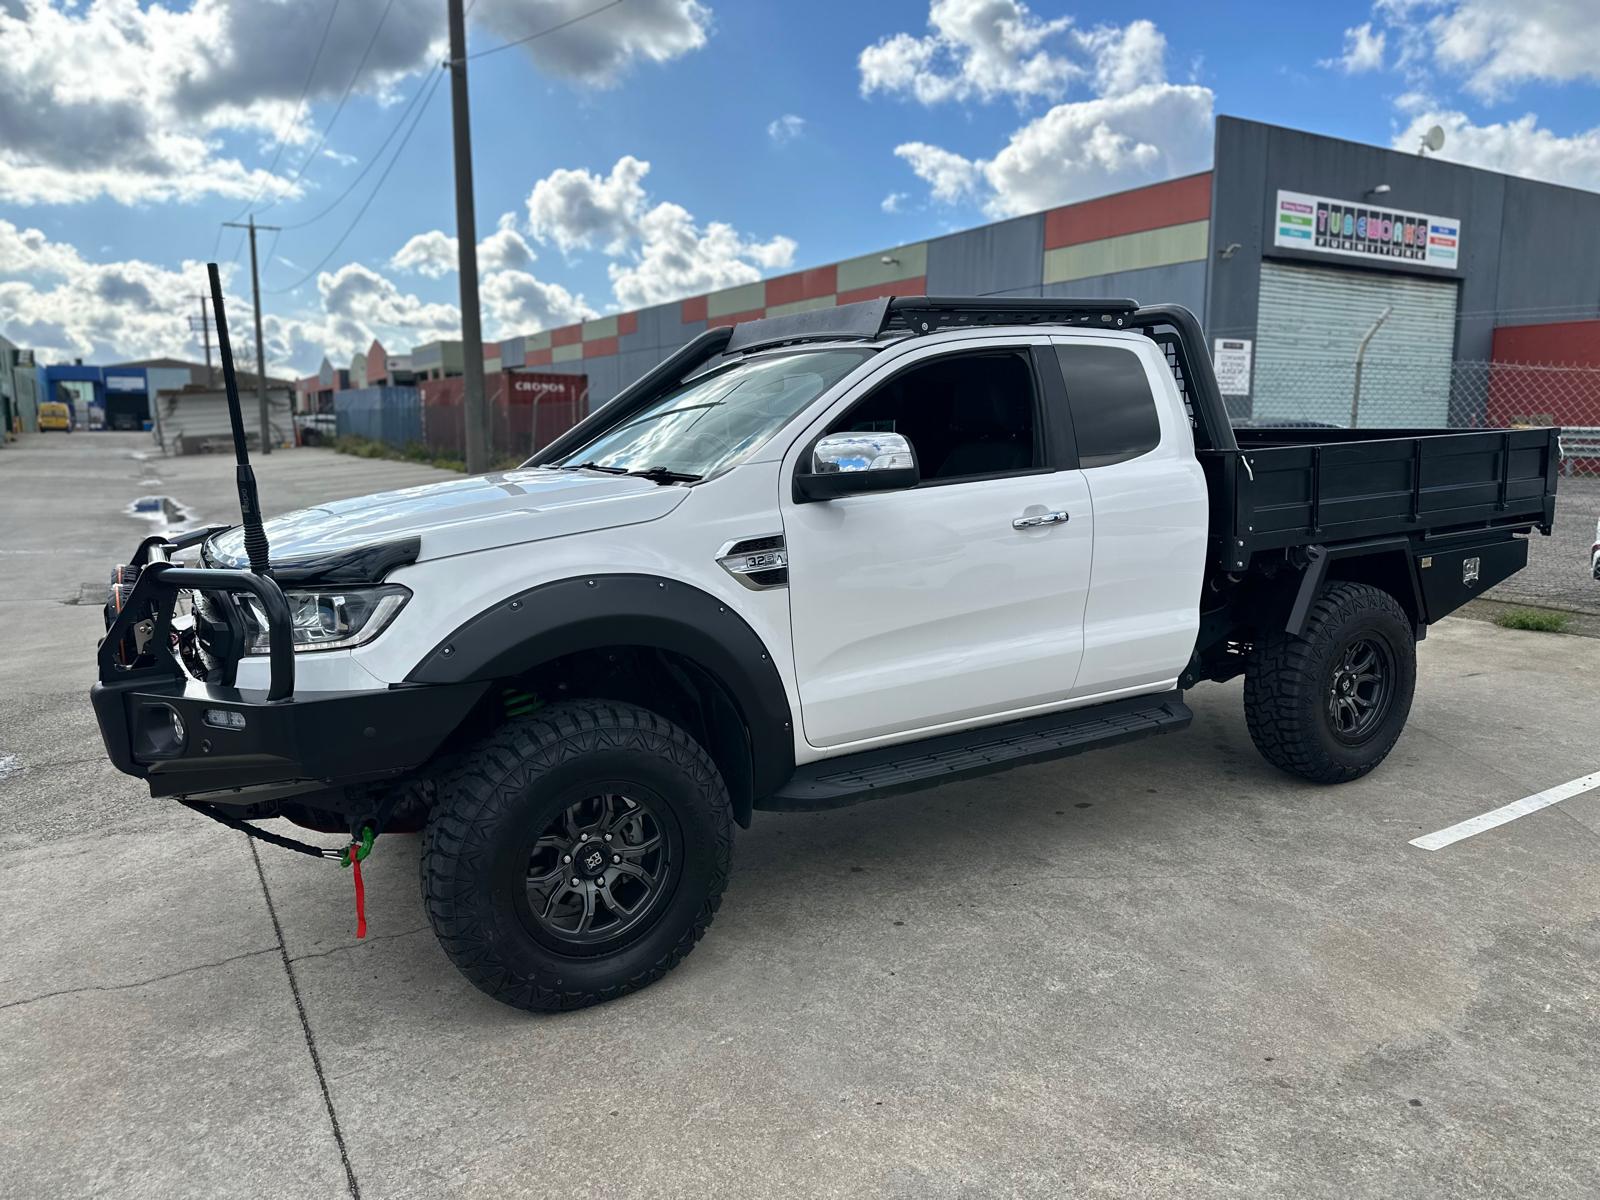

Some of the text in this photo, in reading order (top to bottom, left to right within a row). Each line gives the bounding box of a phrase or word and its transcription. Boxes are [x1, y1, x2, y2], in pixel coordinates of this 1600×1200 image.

[1317, 209, 1427, 246] TUBEWORKS
[1318, 238, 1423, 259] FURNITURE
[515, 382, 565, 393] CRONOS
